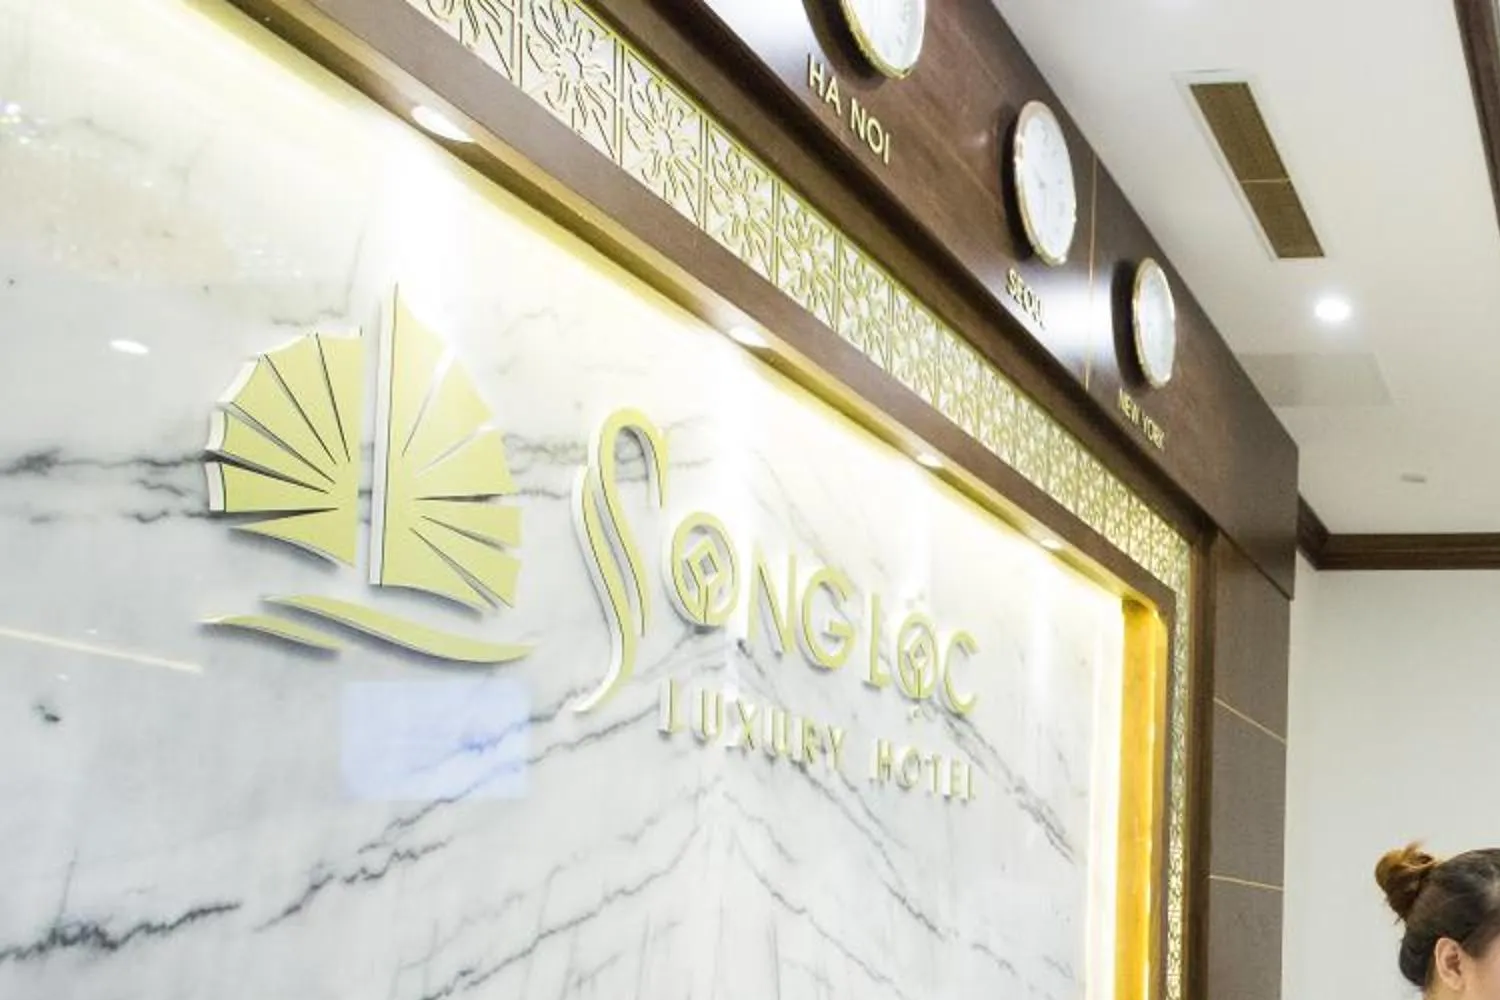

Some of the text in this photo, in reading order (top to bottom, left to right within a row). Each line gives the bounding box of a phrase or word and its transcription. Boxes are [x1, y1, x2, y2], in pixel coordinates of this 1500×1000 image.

[807, 53, 891, 165] HA NOI
[1006, 267, 1046, 330] SEOUL
[1118, 387, 1165, 451] NEW YORK
[570, 407, 858, 713] SONG
[657, 678, 976, 801] LUXURY HOTEL
